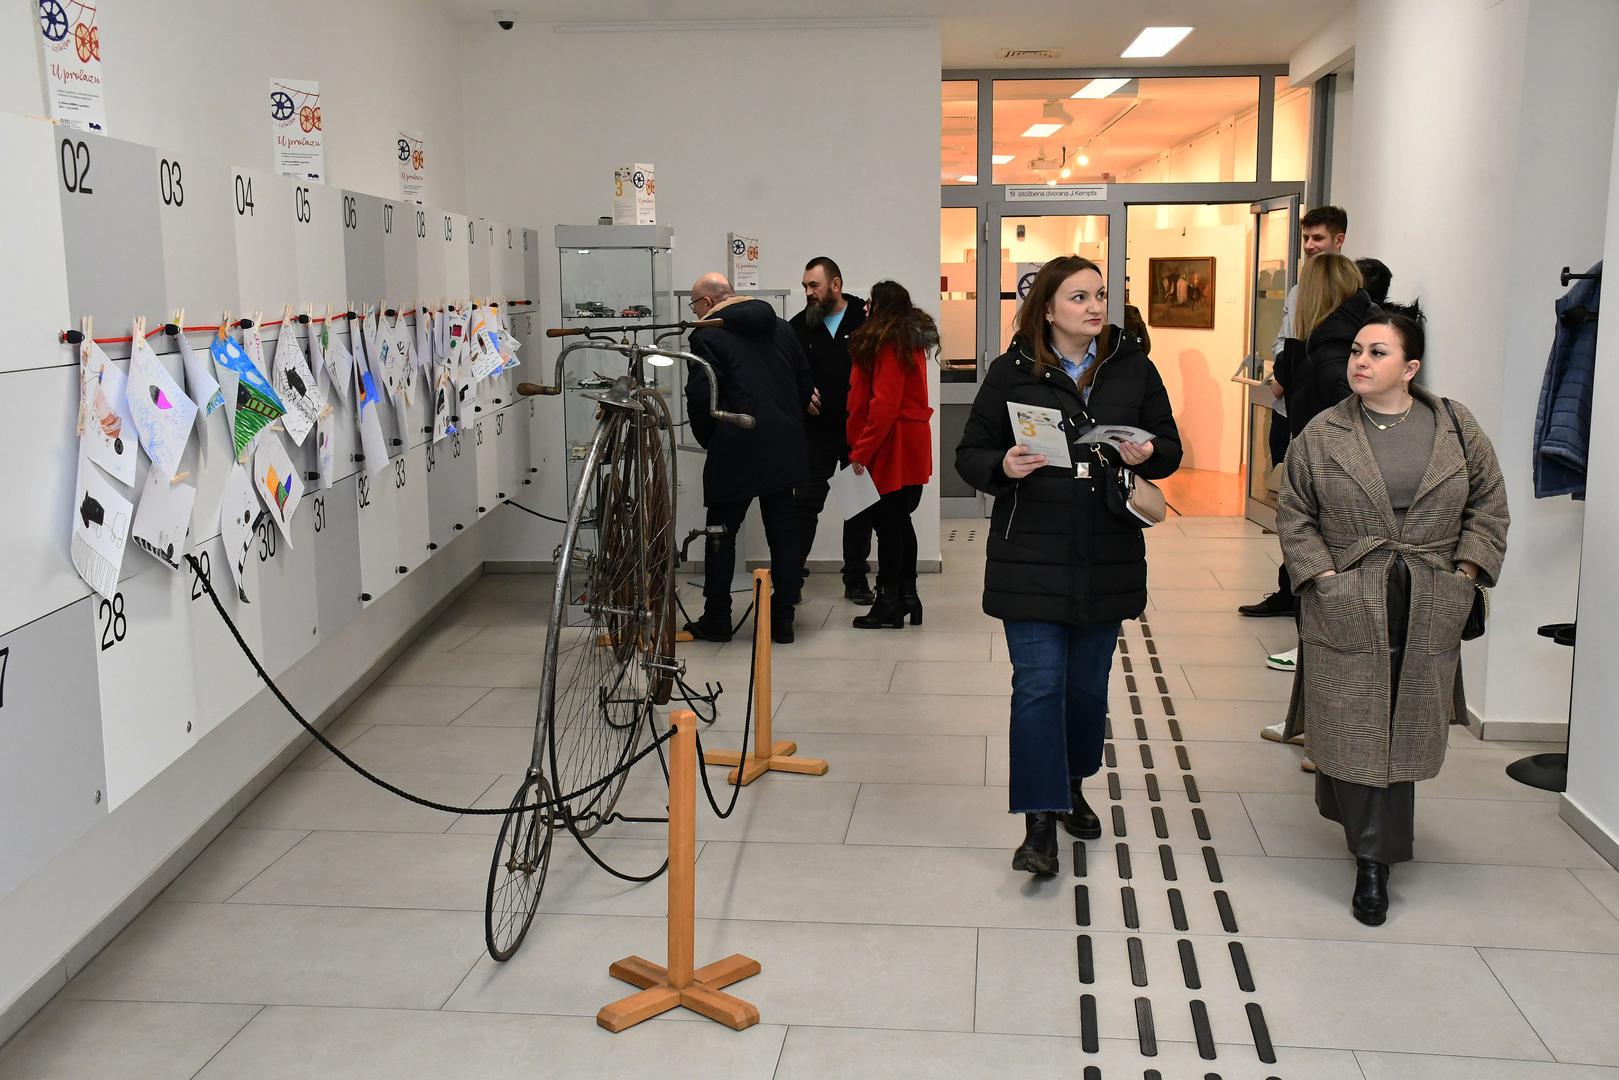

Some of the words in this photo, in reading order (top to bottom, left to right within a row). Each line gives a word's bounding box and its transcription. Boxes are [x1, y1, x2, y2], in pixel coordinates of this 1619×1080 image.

[50, 63, 63, 82] U
[63, 68, 101, 85] prolazu
[276, 135, 287, 147] U
[287, 136, 320, 149] prolazu
[61, 139, 92, 194] 02
[161, 159, 183, 207] 03
[236, 175, 254, 216] 04
[296, 187, 310, 223] 05
[344, 196, 356, 229] 06
[384, 203, 393, 234] 07
[416, 209, 426, 239] 08
[444, 215, 452, 242] 09
[496, 413, 504, 436] 37
[425, 445, 436, 472] 34
[452, 432, 461, 459] 35
[395, 458, 406, 489] 33
[359, 474, 370, 508] 32
[314, 496, 325, 532] 31
[259, 519, 276, 562] 30
[189, 550, 211, 601] 29
[98, 593, 127, 651] 28
